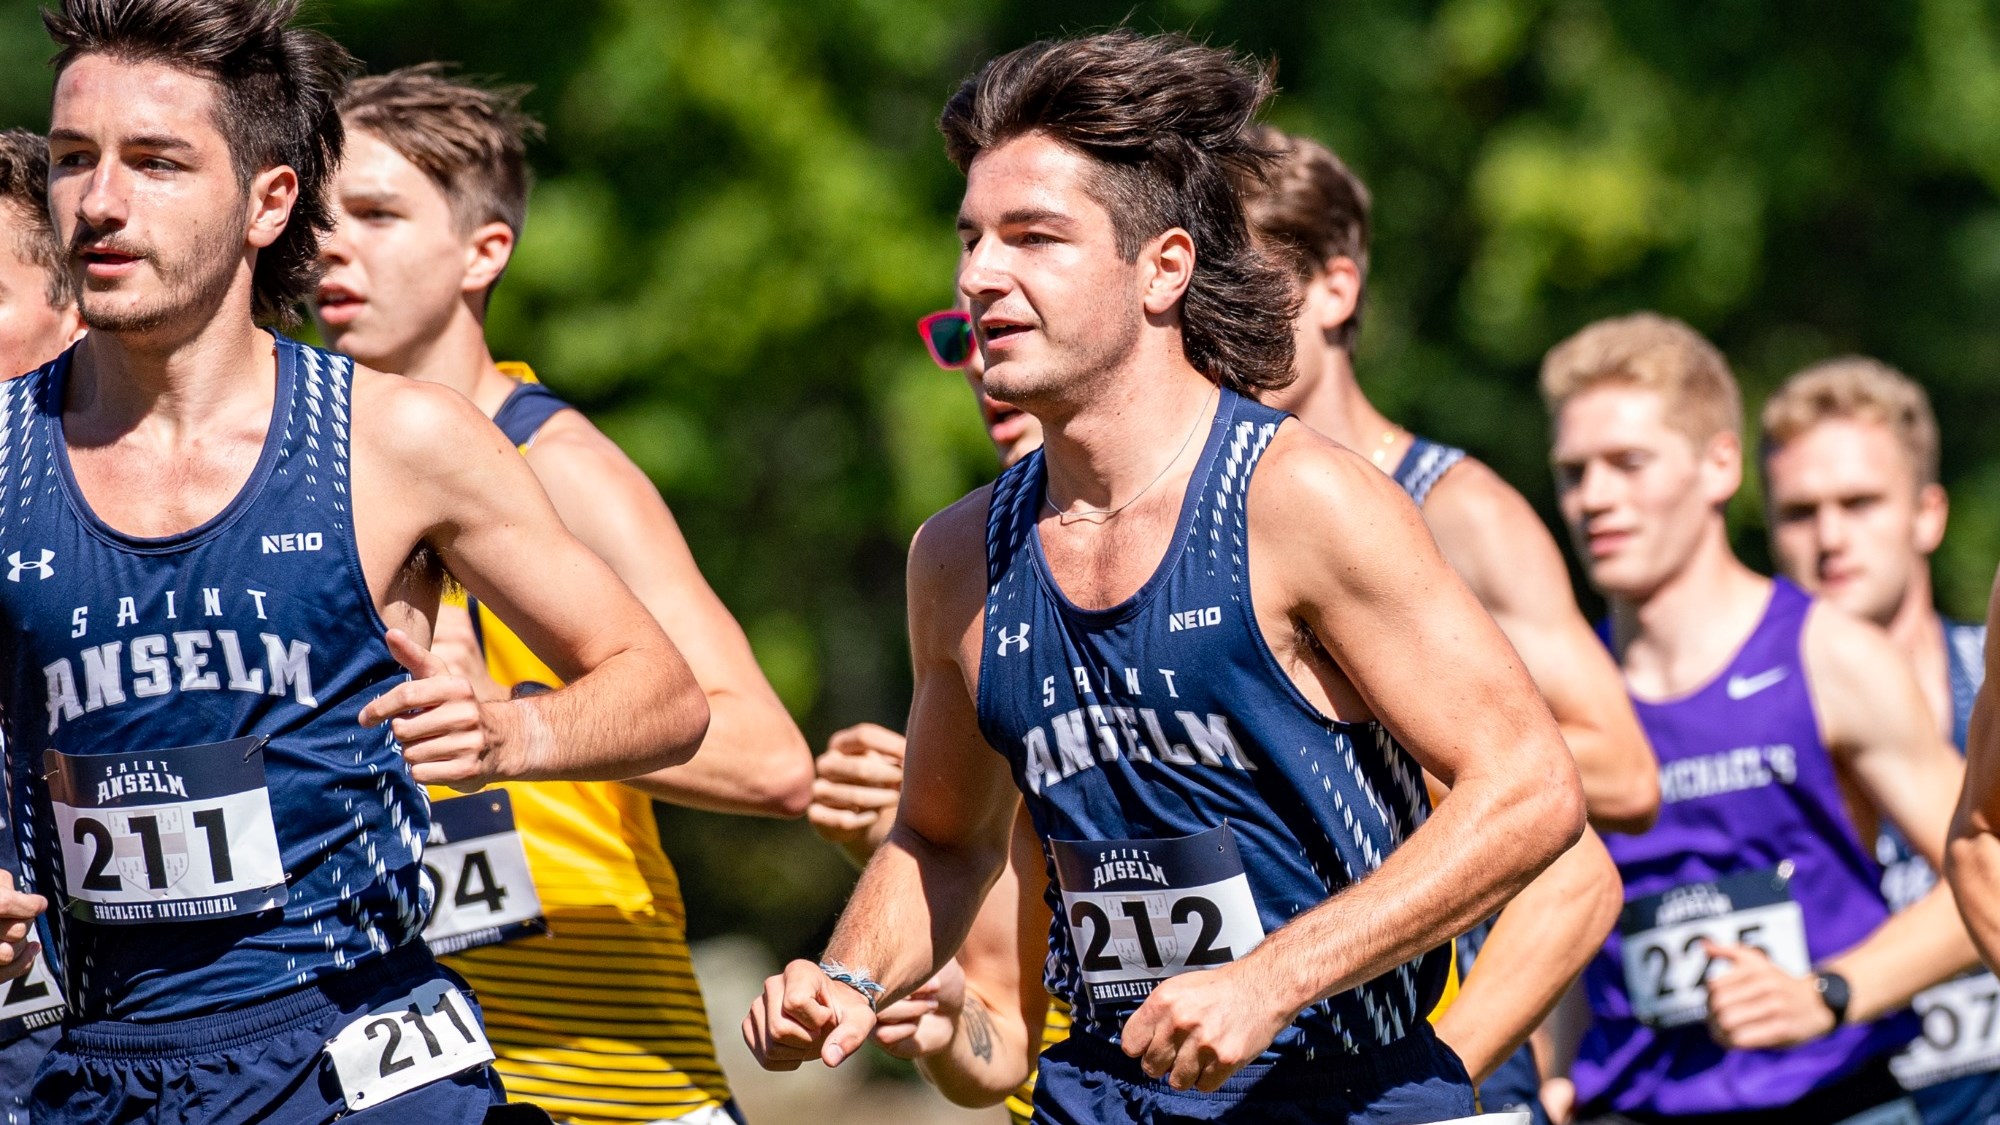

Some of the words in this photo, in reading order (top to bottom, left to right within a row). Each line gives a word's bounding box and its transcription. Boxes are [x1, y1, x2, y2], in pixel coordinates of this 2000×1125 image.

[261, 532, 323, 554] NE10
[71, 587, 267, 638] SAINT
[1169, 606, 1222, 632] NE10
[43, 629, 319, 735] ANSELM
[1043, 666, 1179, 707] SAINT
[106, 760, 169, 777] SAINT
[1022, 704, 1258, 798] ANSELM
[97, 772, 189, 805] ANSELM
[73, 807, 234, 892] 211
[1100, 848, 1150, 862] SAINT
[1093, 860, 1169, 889] ANSELM
[158, 896, 237, 917] INVITATIONAL
[1071, 896, 1234, 971] 212
[364, 992, 477, 1078] 211
